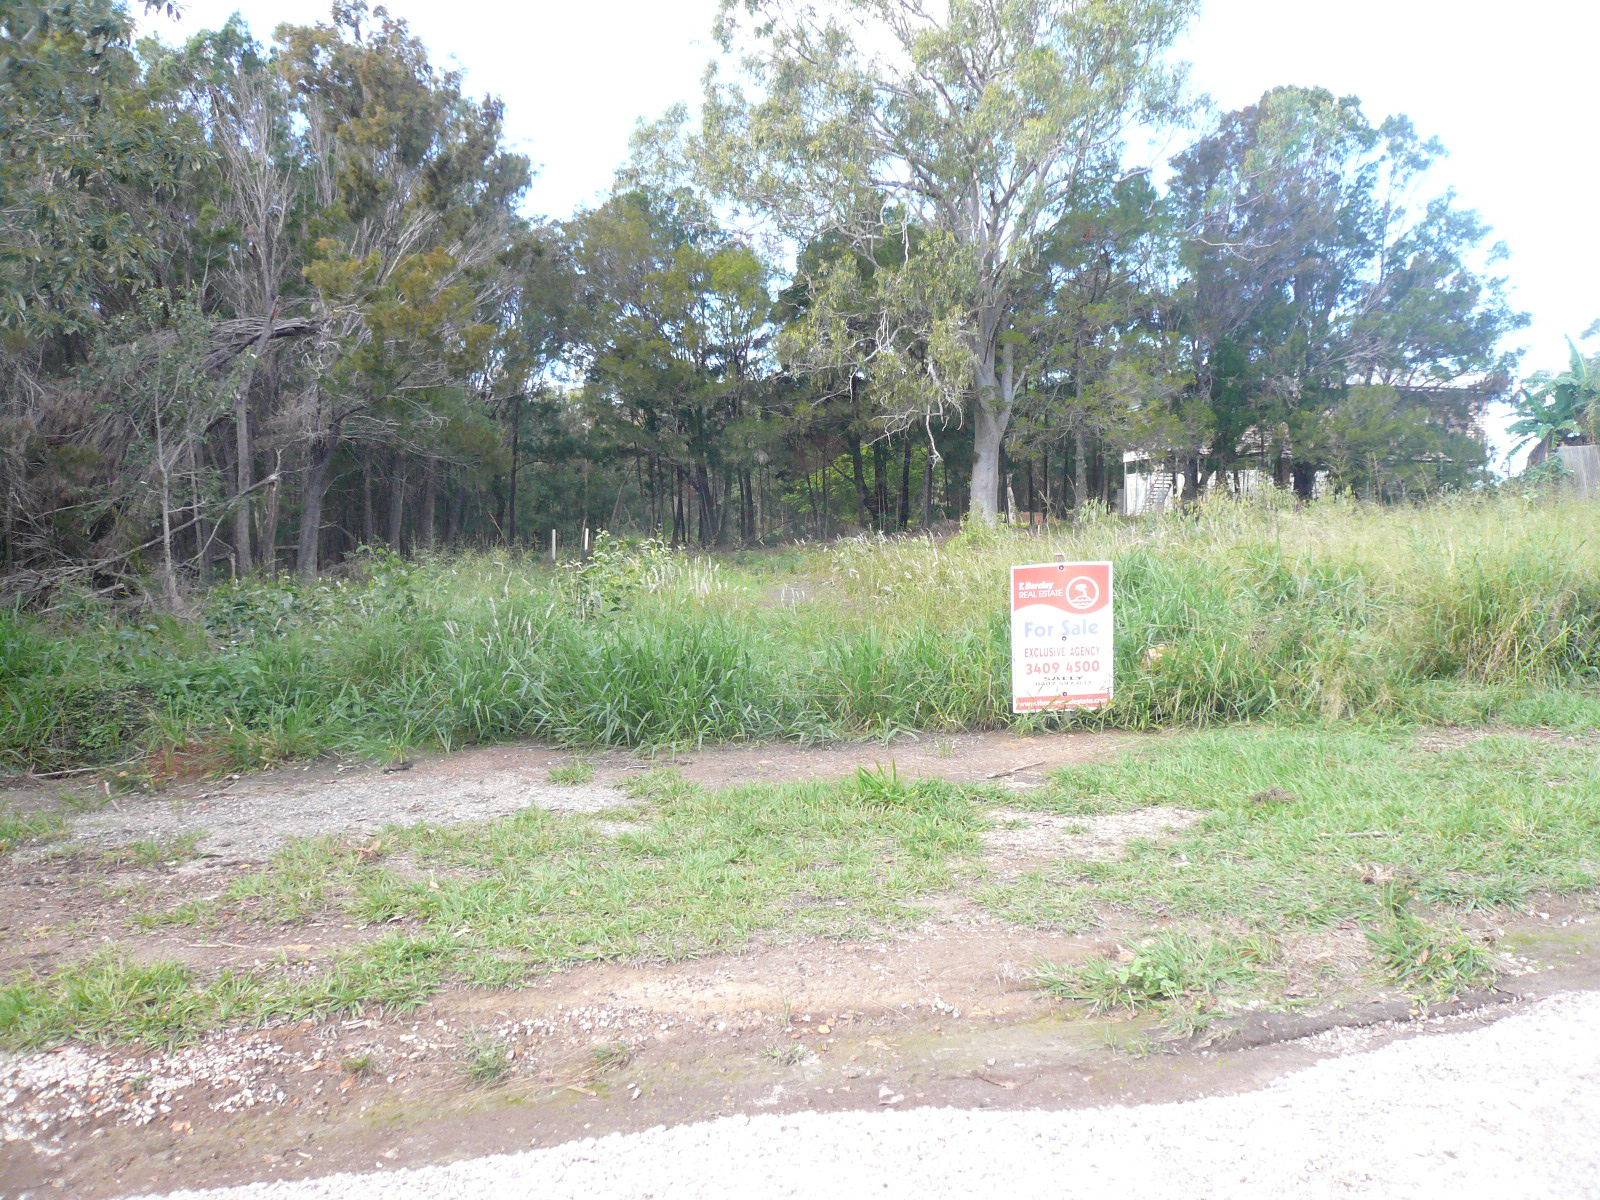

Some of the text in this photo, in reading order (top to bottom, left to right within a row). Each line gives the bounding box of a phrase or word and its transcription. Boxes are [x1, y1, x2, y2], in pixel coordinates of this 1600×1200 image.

[1019, 589, 1064, 599] REAL ESTATE
[1024, 618, 1098, 638] For Sale
[1024, 646, 1100, 658] EXCLUSIVE AGENCY
[1025, 659, 1100, 675] 3409 4500
